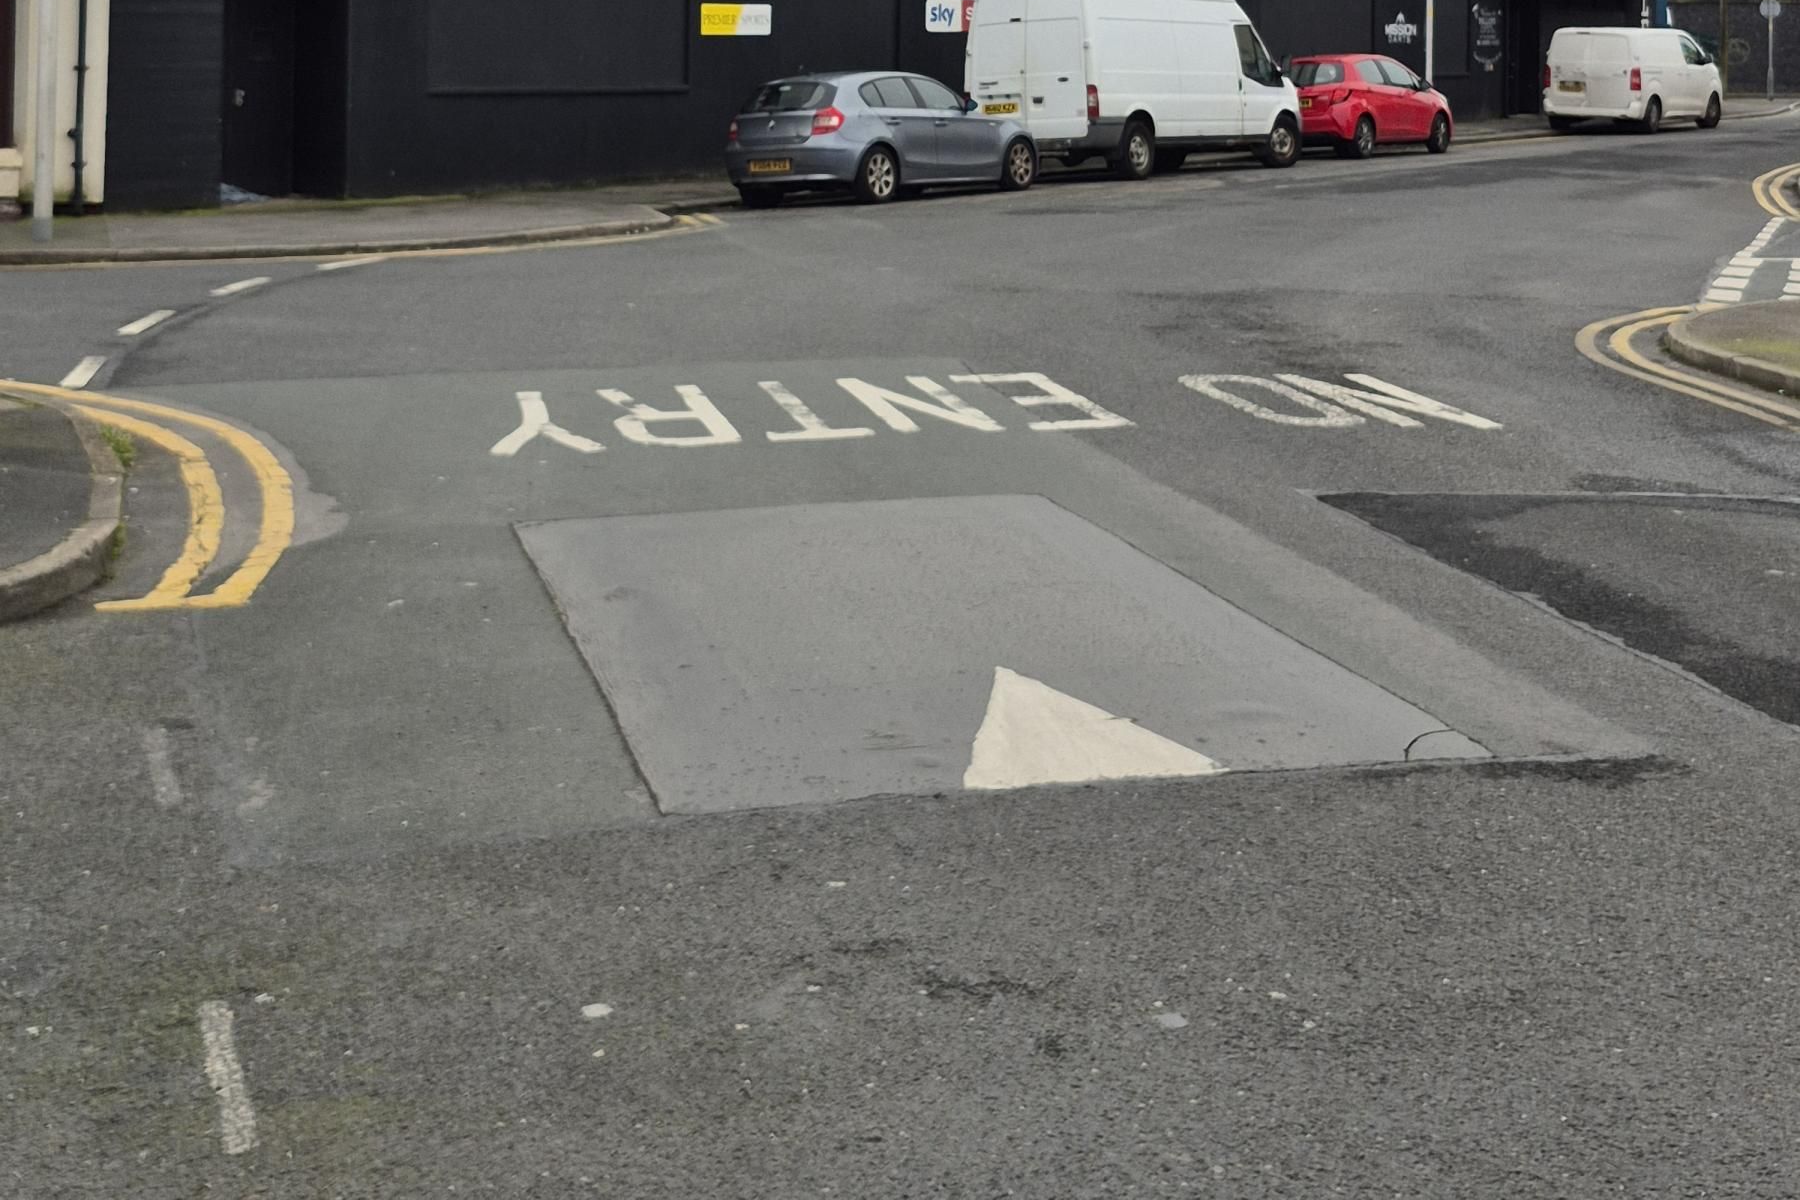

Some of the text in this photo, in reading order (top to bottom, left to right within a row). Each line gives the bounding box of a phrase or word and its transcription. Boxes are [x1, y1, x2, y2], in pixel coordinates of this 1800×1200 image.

[930, 3, 955, 27] sky
[490, 372, 1503, 456] NO ENTRY
